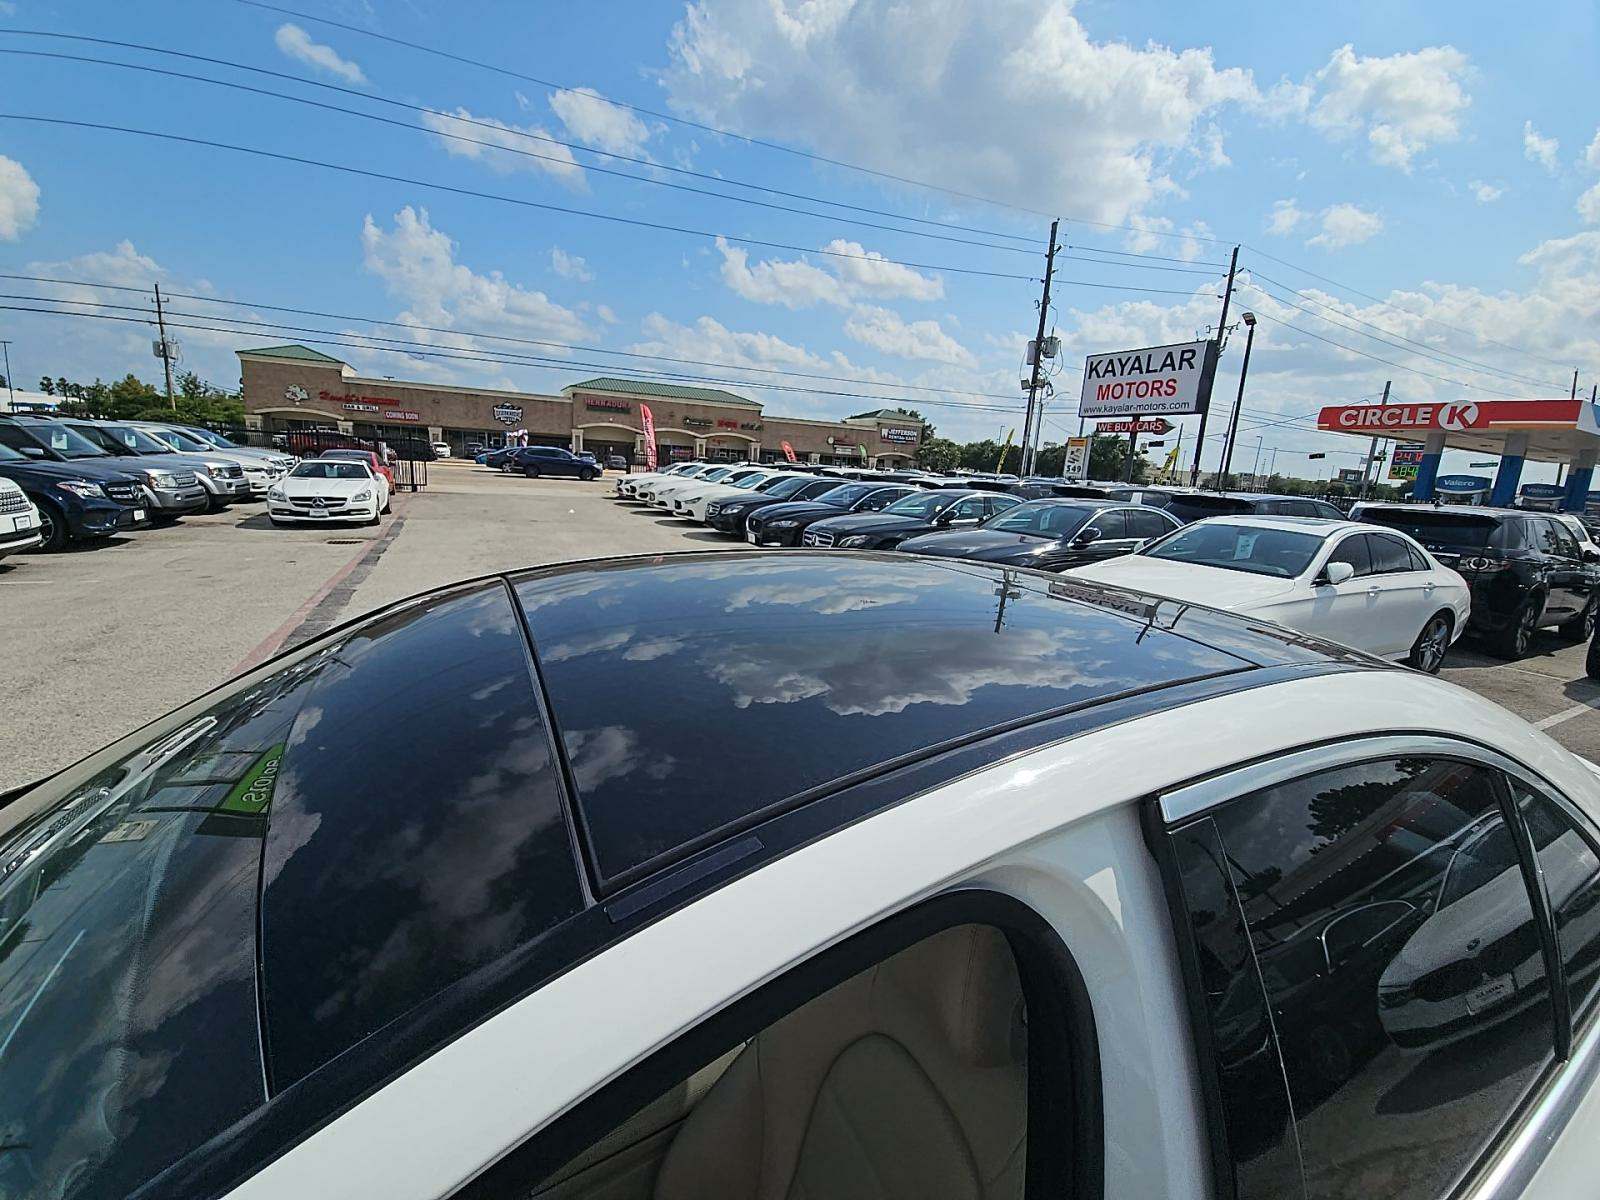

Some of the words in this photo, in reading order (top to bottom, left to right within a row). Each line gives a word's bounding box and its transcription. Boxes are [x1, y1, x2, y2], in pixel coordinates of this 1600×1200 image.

[1088, 349, 1197, 379] KAYALAR
[1096, 378, 1178, 400] MOTORS
[1083, 401, 1190, 414] www.kayalar-motors.com
[1098, 423, 1112, 431] WE
[1115, 422, 1136, 431] BUY
[1136, 421, 1163, 431] CARS
[1339, 407, 1433, 426] CIRCLE
[1447, 405, 1473, 430] K
[1444, 479, 1475, 487] Valero
